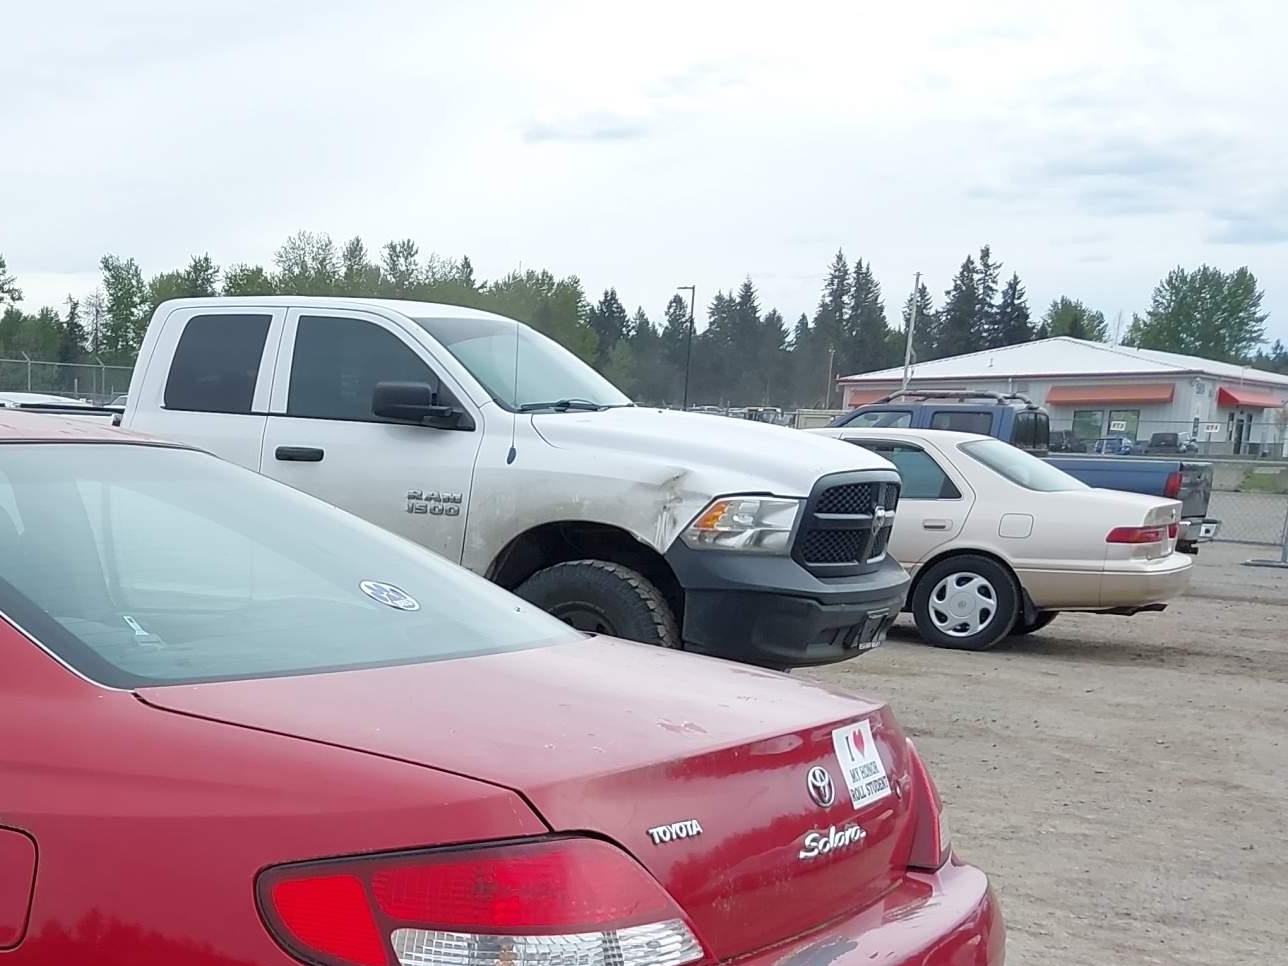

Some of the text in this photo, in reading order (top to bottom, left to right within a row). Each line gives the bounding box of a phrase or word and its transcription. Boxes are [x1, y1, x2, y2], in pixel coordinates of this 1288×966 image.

[407, 490, 462, 503] RAM
[407, 503, 460, 516] 1500
[849, 761, 880, 784] MY HONOR
[850, 776, 888, 802] ROLL STUDENT
[646, 819, 703, 844] TOYOTA
[798, 825, 868, 859] Solara
